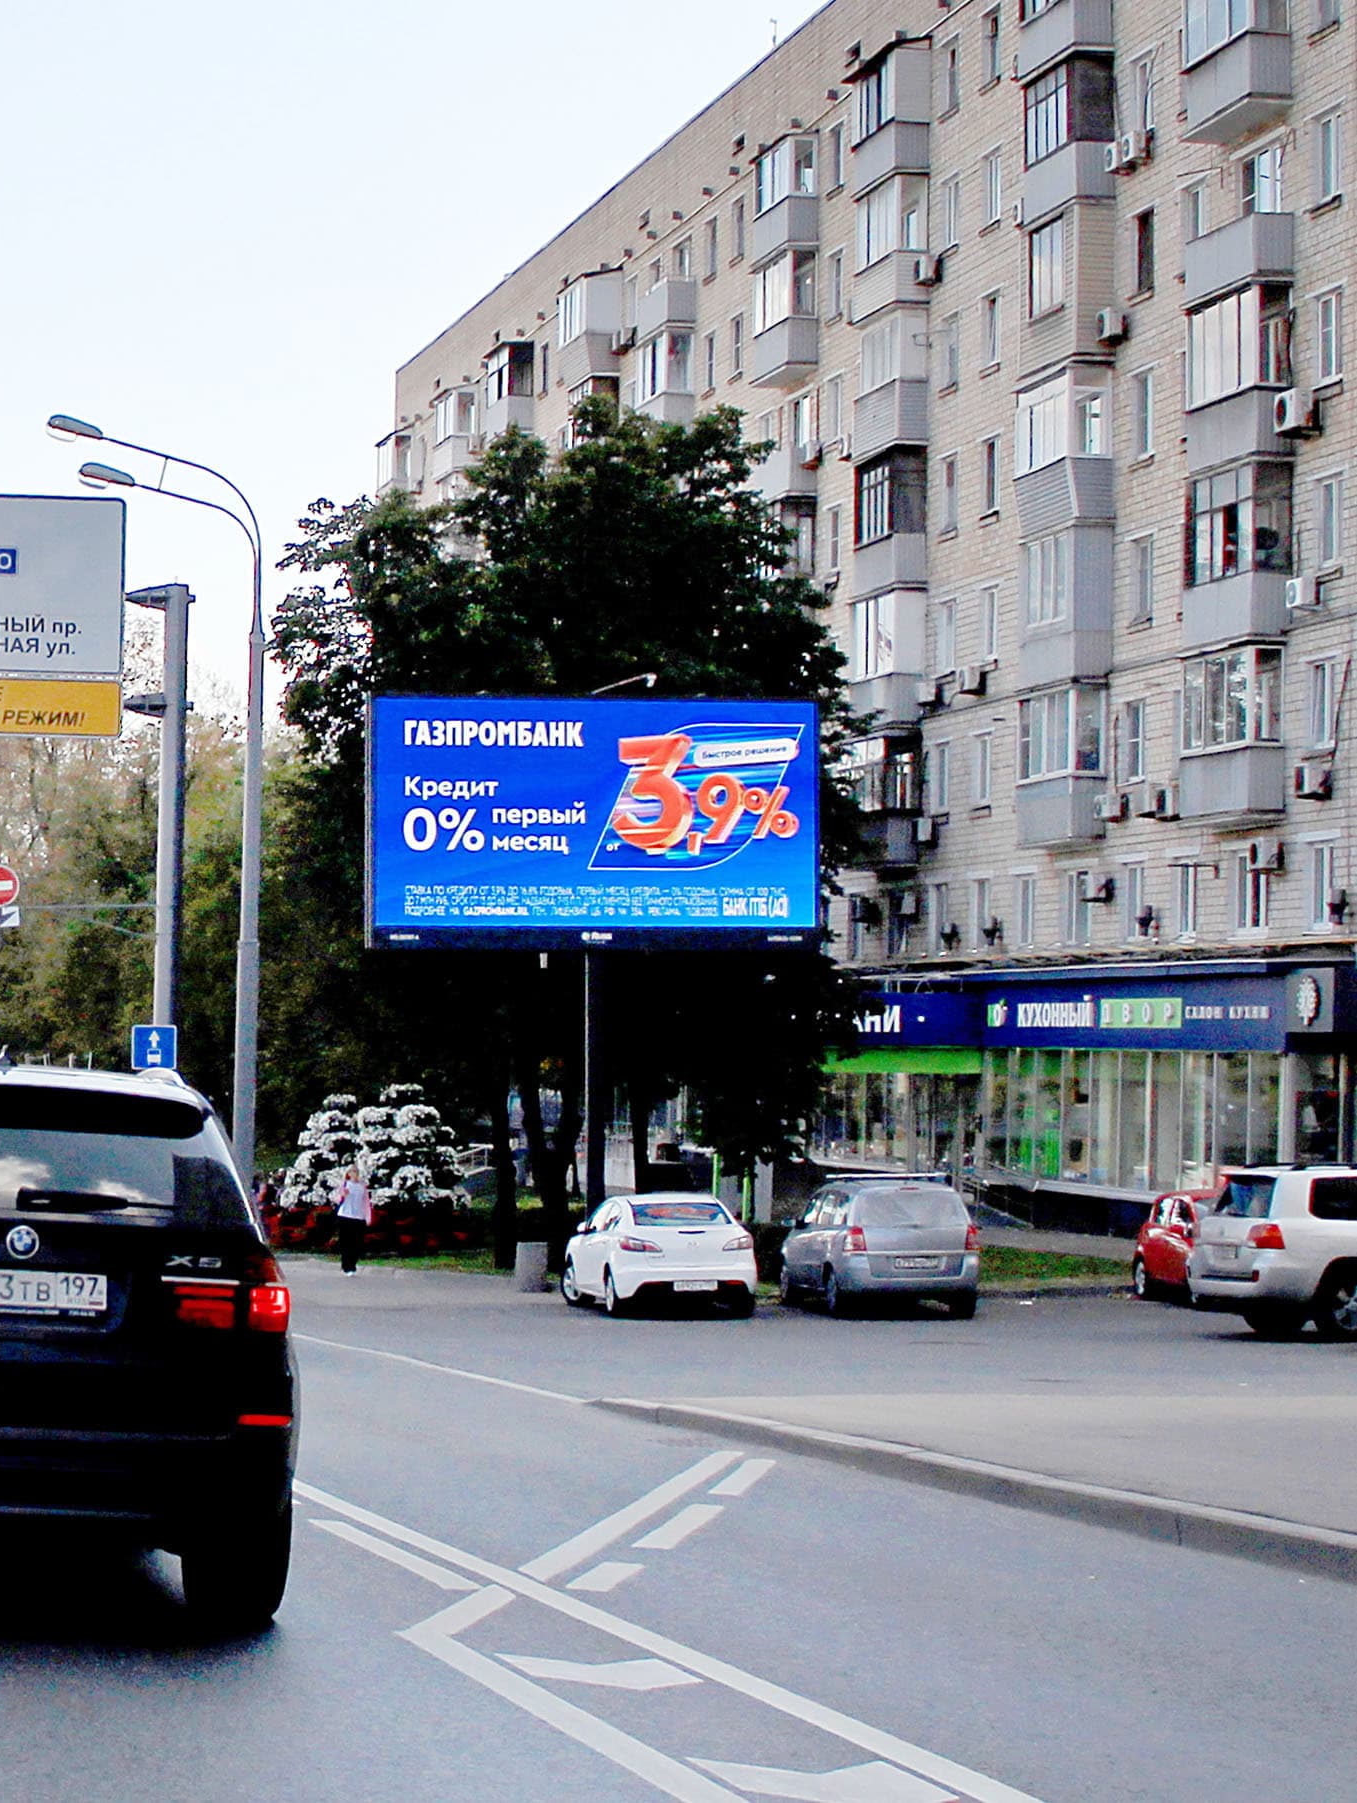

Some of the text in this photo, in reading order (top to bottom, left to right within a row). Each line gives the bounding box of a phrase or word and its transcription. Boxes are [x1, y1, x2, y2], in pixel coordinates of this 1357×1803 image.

[52, 620, 82, 639] пр.
[45, 641, 76, 659] ул.
[2, 708, 85, 727] РЕЖИМ!
[403, 719, 584, 747] ГАЗПРОМБАНК
[701, 747, 742, 760] Быстрое
[404, 775, 499, 801] Кредит
[606, 733, 800, 856] от 3,9%
[491, 801, 586, 829] первый
[403, 807, 485, 852] 0%
[491, 835, 570, 855] месяц
[1017, 995, 1095, 1027] КУХОННЫЙ
[1101, 1003, 1175, 1025] ДВОР
[59, 1276, 100, 1297] 197
